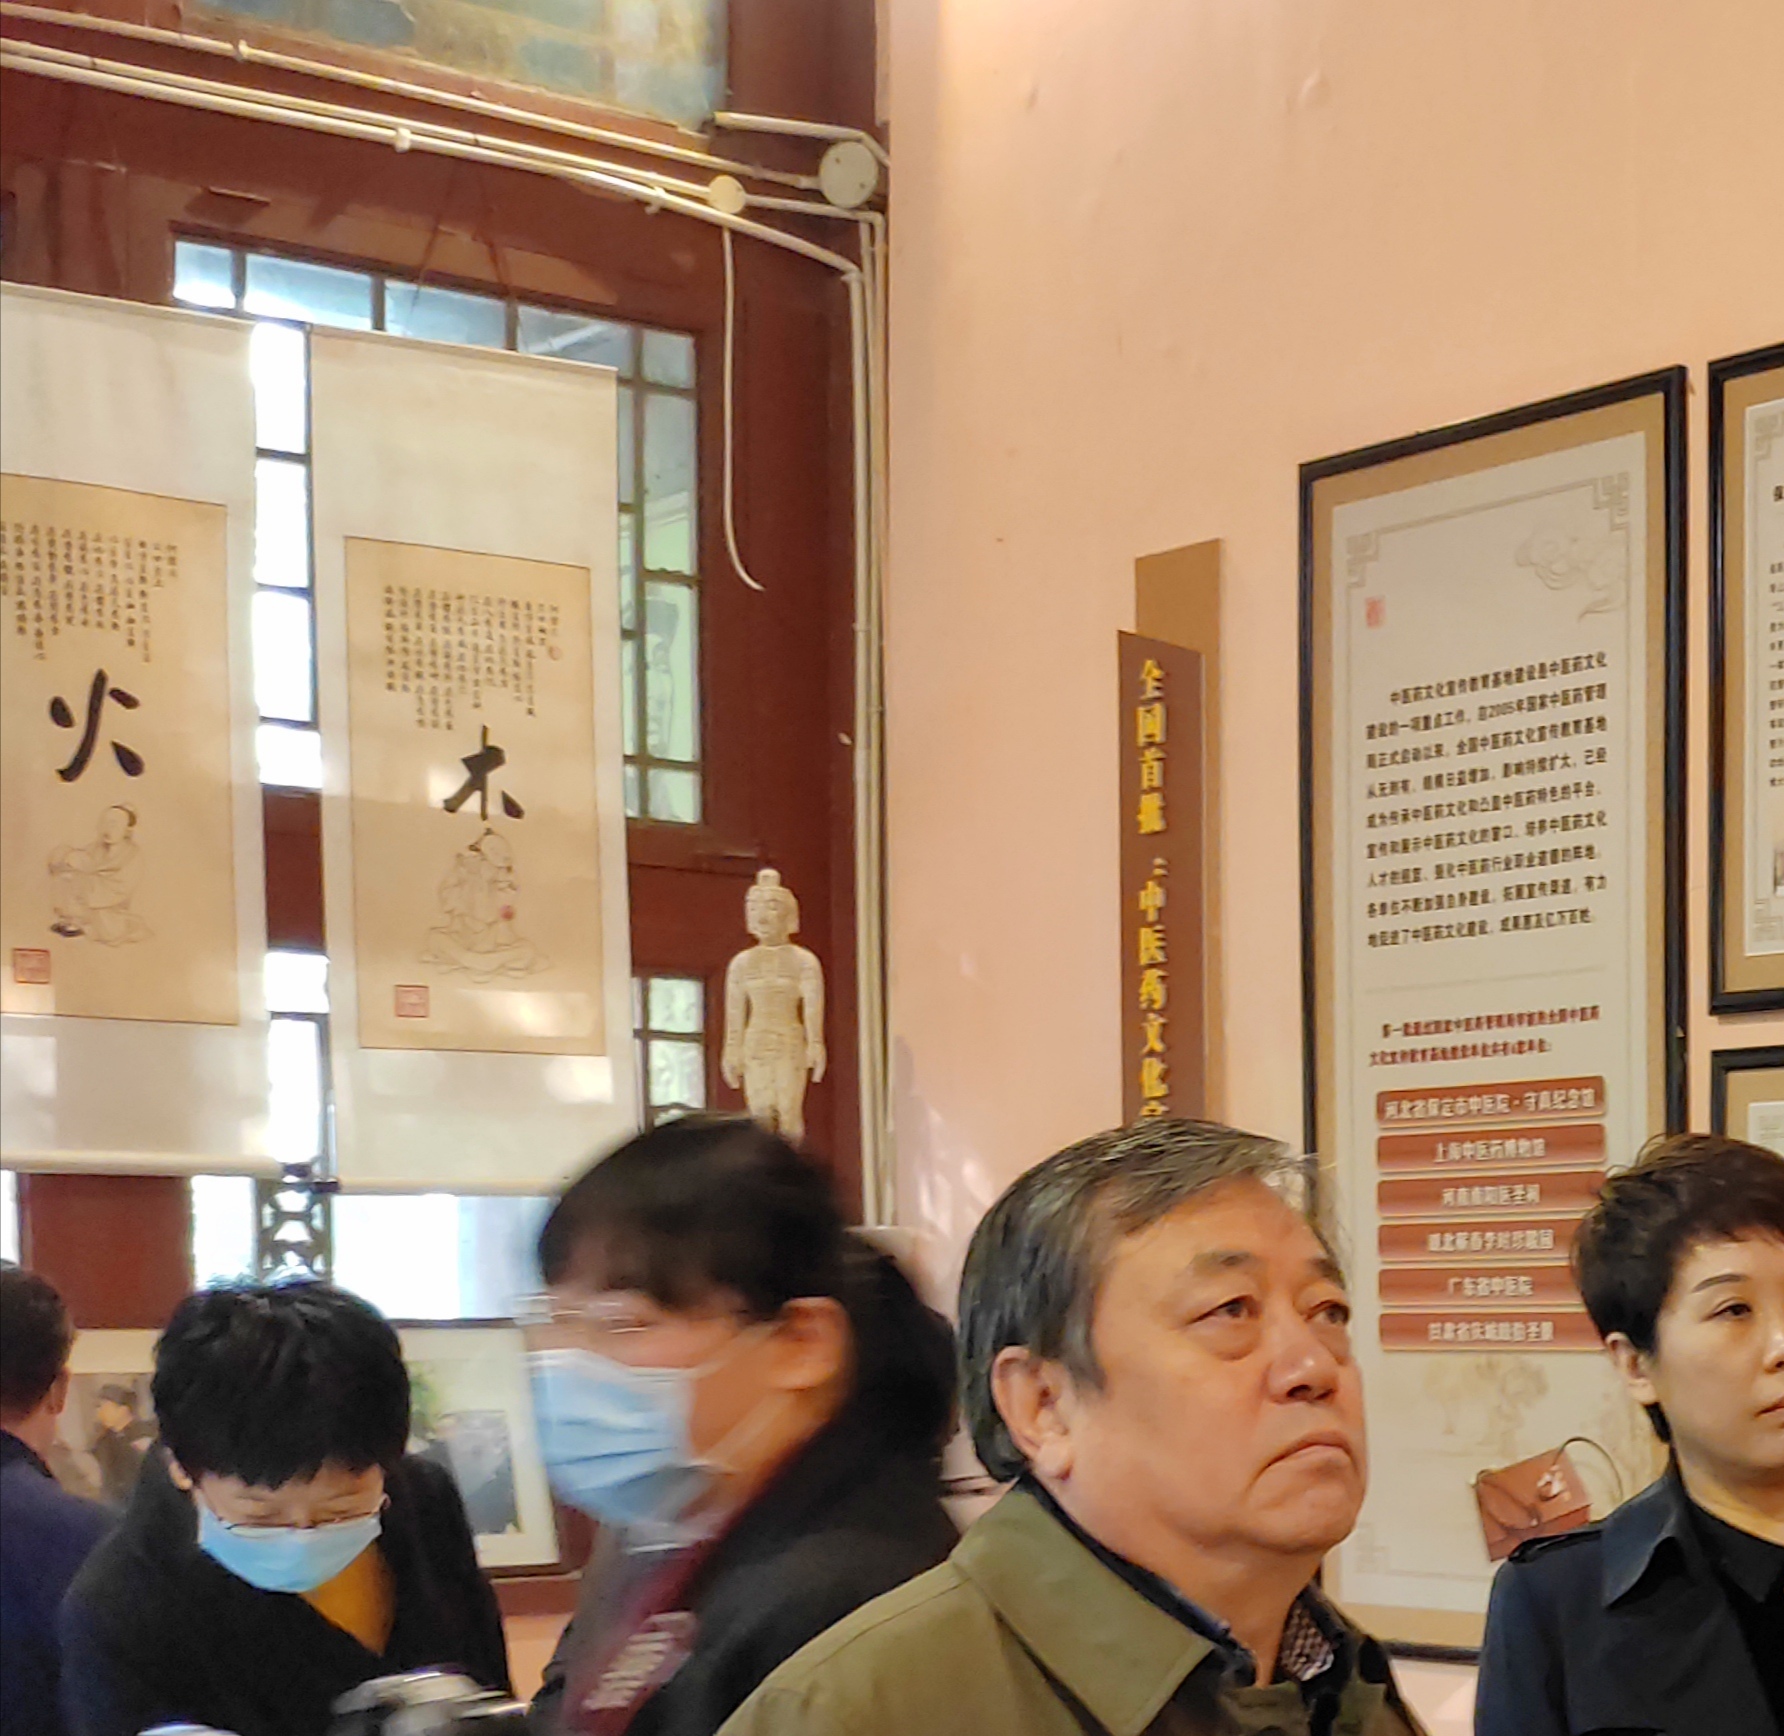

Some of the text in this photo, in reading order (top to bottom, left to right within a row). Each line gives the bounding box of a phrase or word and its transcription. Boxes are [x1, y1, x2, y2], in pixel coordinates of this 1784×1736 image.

[49, 668, 145, 783] 火
[443, 725, 525, 821] 木
[1449, 1277, 1533, 1297] 广东省中医院
